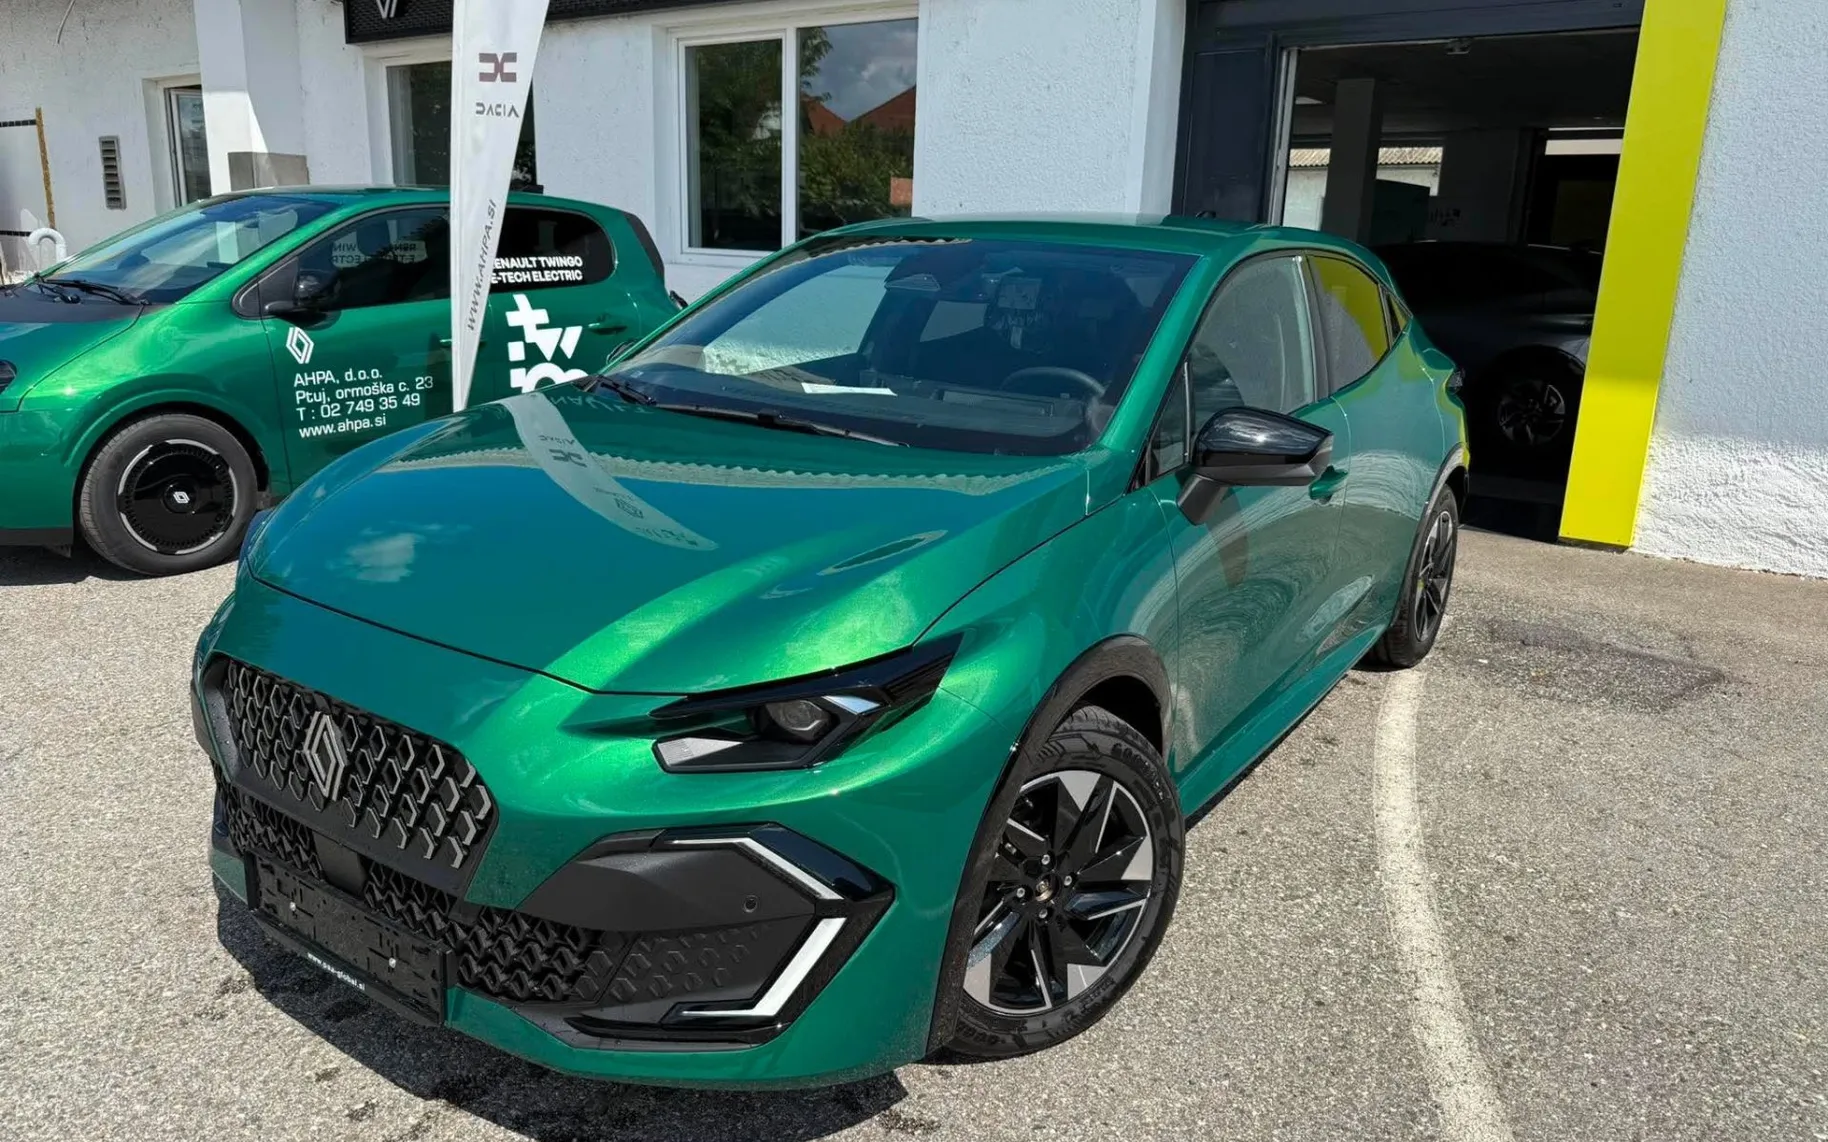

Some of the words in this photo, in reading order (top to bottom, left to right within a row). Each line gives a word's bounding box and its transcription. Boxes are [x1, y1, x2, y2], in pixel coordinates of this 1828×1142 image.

[475, 102, 519, 118] DACIA
[467, 199, 498, 331] WWW.AHPA.SI
[493, 257, 538, 269] ENAULT
[538, 256, 583, 268] TWINGO
[491, 271, 531, 284] E-TECH
[532, 270, 583, 282] ELECTRIC
[294, 370, 340, 387] AHPA,
[344, 368, 383, 382] d.o.o.
[295, 388, 331, 405] Ptuj,
[335, 381, 395, 399] ormoška
[398, 382, 410, 392] c.
[415, 376, 434, 390] 23
[320, 403, 341, 418] 02
[345, 399, 375, 414] 749
[379, 396, 398, 410] 35
[402, 393, 421, 406] 49
[299, 413, 387, 438] www.ahpa.si
